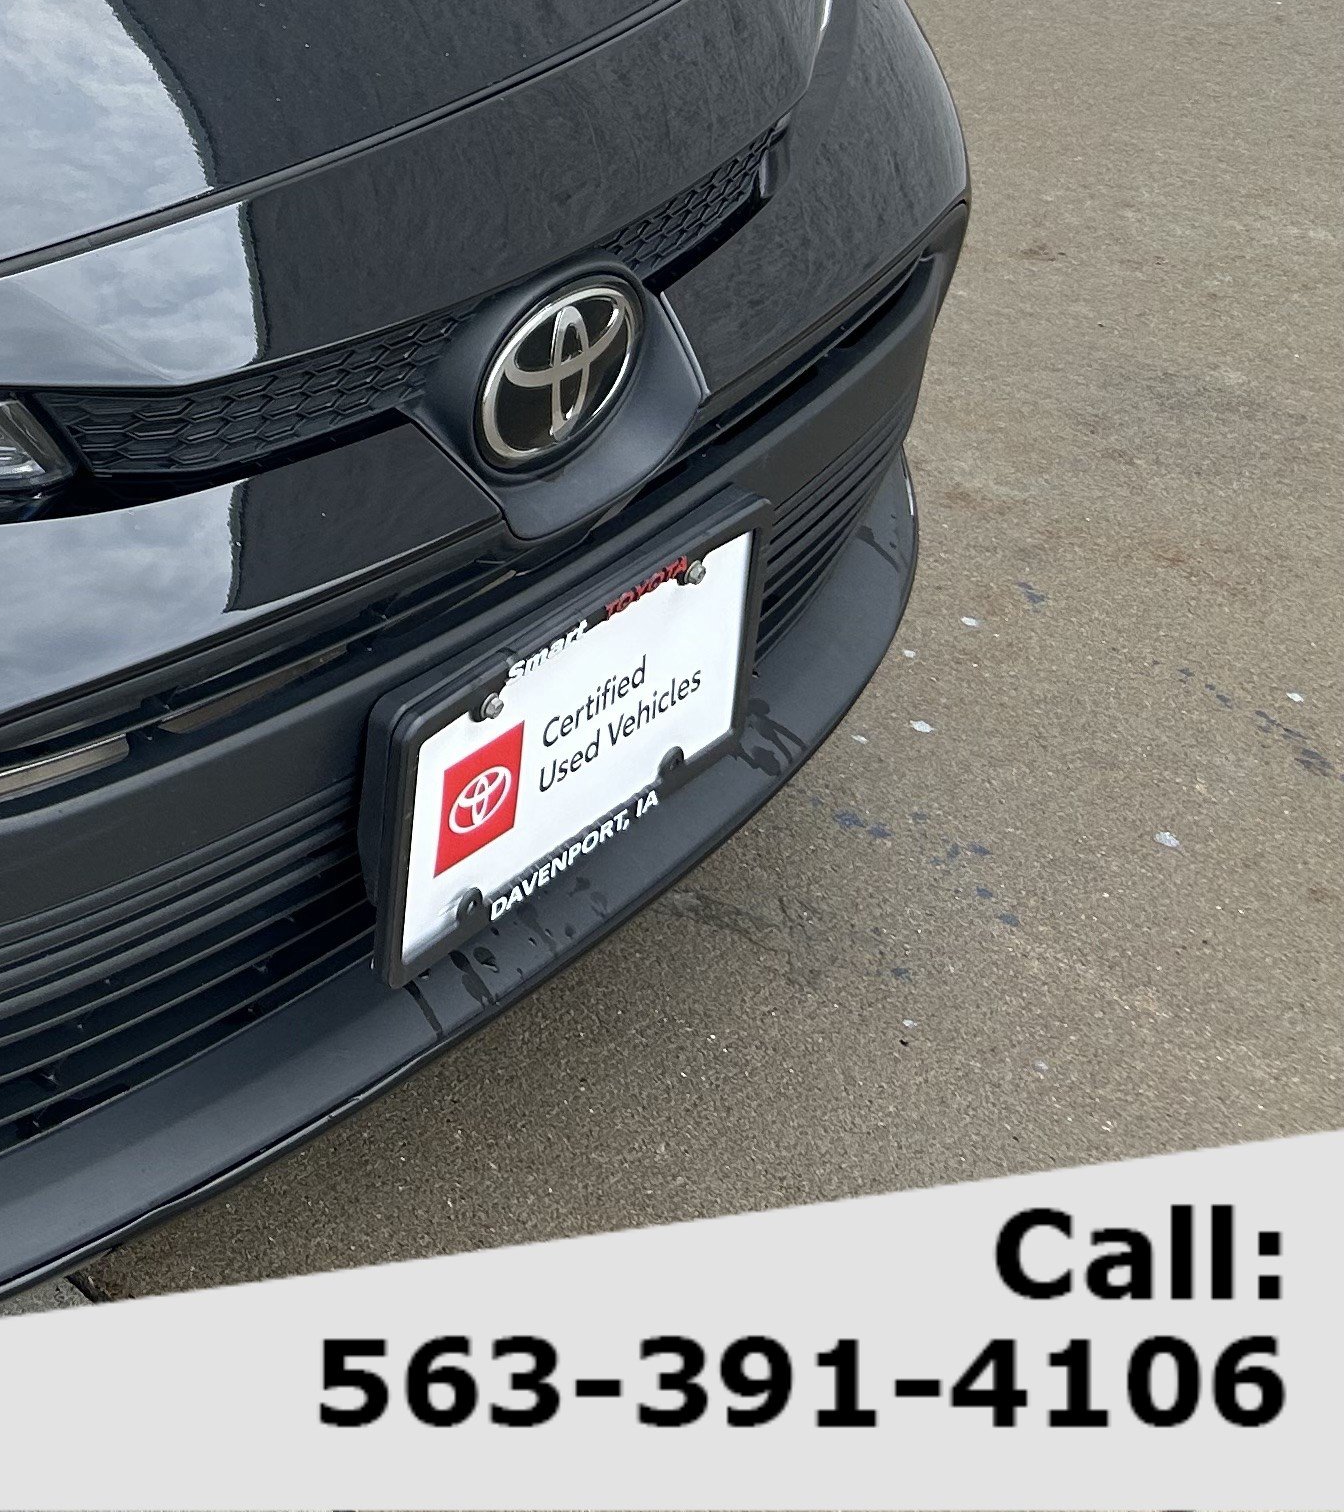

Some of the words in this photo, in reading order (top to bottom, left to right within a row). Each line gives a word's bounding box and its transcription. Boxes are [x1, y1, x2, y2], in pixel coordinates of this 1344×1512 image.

[508, 619, 588, 678] Smart
[604, 555, 689, 620] TOYOTA
[539, 735, 600, 793] Used
[607, 669, 702, 747] Vehicles
[542, 655, 648, 748] Certified
[489, 809, 631, 922] DAVENPORT,
[635, 789, 660, 817] IA
